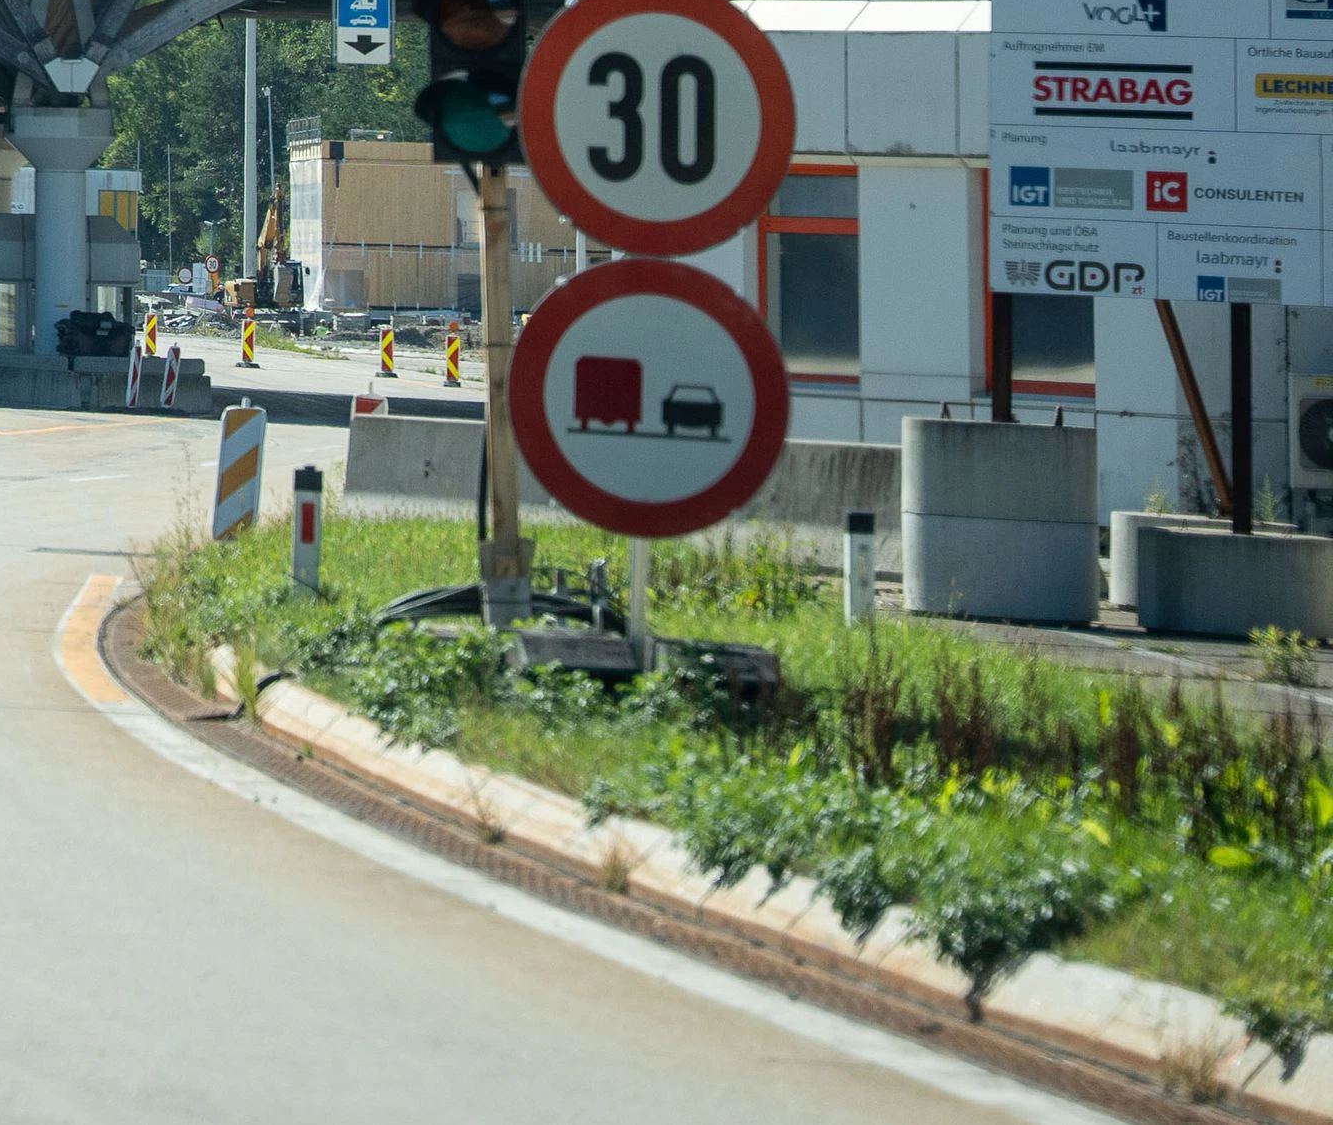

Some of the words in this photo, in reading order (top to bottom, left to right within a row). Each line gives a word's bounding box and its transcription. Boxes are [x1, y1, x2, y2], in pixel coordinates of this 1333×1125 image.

[1033, 76, 1193, 106] STRABAG
[589, 51, 715, 185] 30
[1001, 131, 1048, 145] Planung
[1110, 140, 1201, 158] laabmayr
[1013, 184, 1048, 204] IGT
[1153, 180, 1181, 204] iC
[1194, 187, 1305, 204] CONSULENTEN
[1002, 224, 1047, 237] Planung
[1049, 226, 1072, 237] und
[1167, 230, 1298, 246] Baustellenkoordination
[1002, 239, 1100, 253] Steinschlagschutz
[1196, 250, 1270, 268] laabmayr
[1044, 260, 1145, 293] GDP
[1200, 288, 1224, 302] IGT
